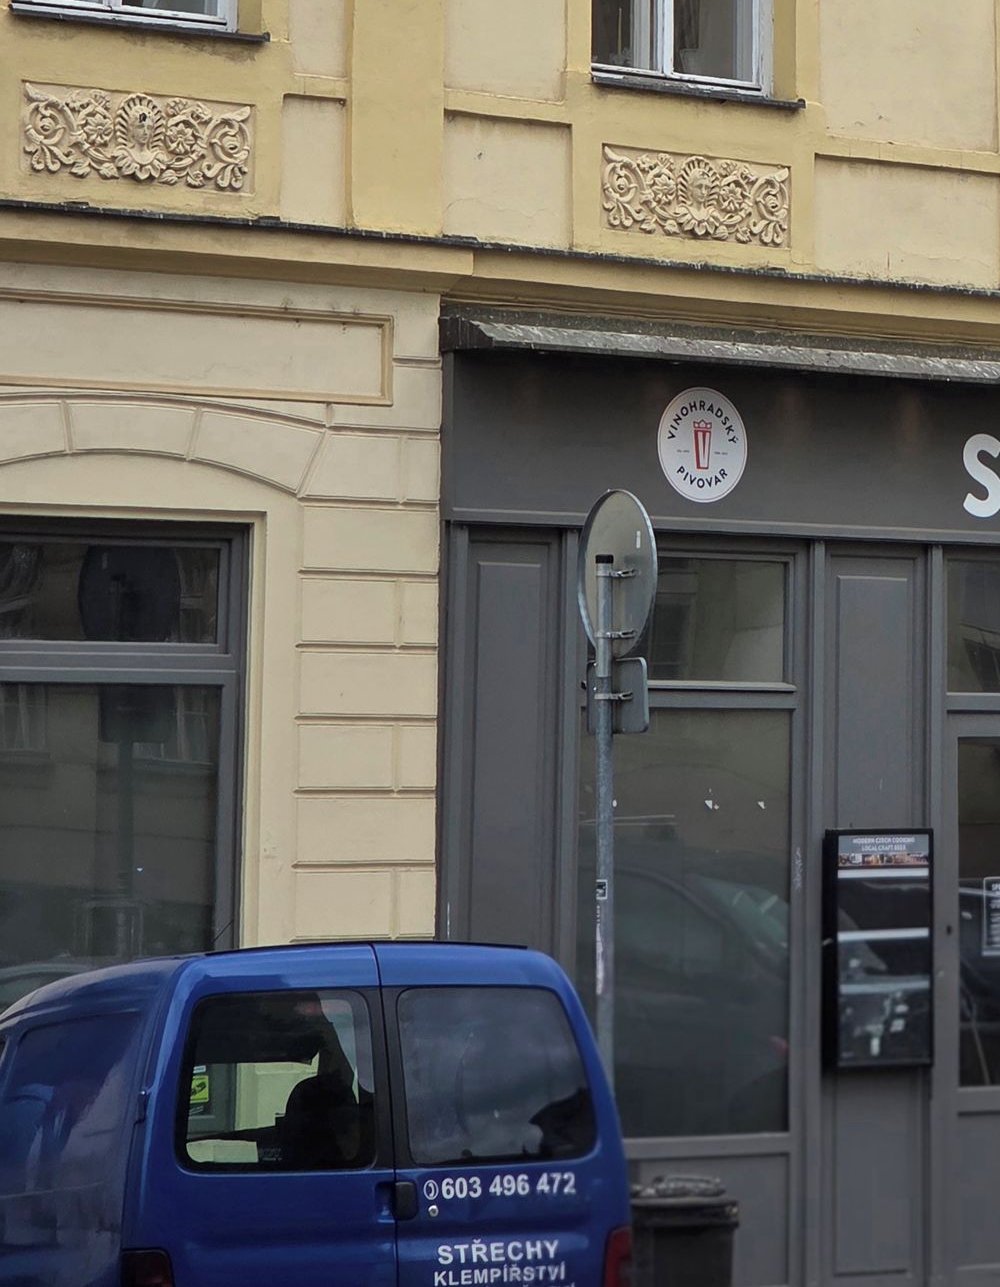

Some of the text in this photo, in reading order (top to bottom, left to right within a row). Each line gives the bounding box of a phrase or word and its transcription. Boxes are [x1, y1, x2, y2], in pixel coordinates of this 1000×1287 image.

[667, 400, 739, 444] VINOHRADSKÝ
[677, 466, 728, 488] PIVOVAR
[441, 1172, 577, 1200] 603 496 472
[437, 1238, 559, 1265] STŘECHY
[434, 1261, 566, 1286] KLEMPÍŘSTVÍ
